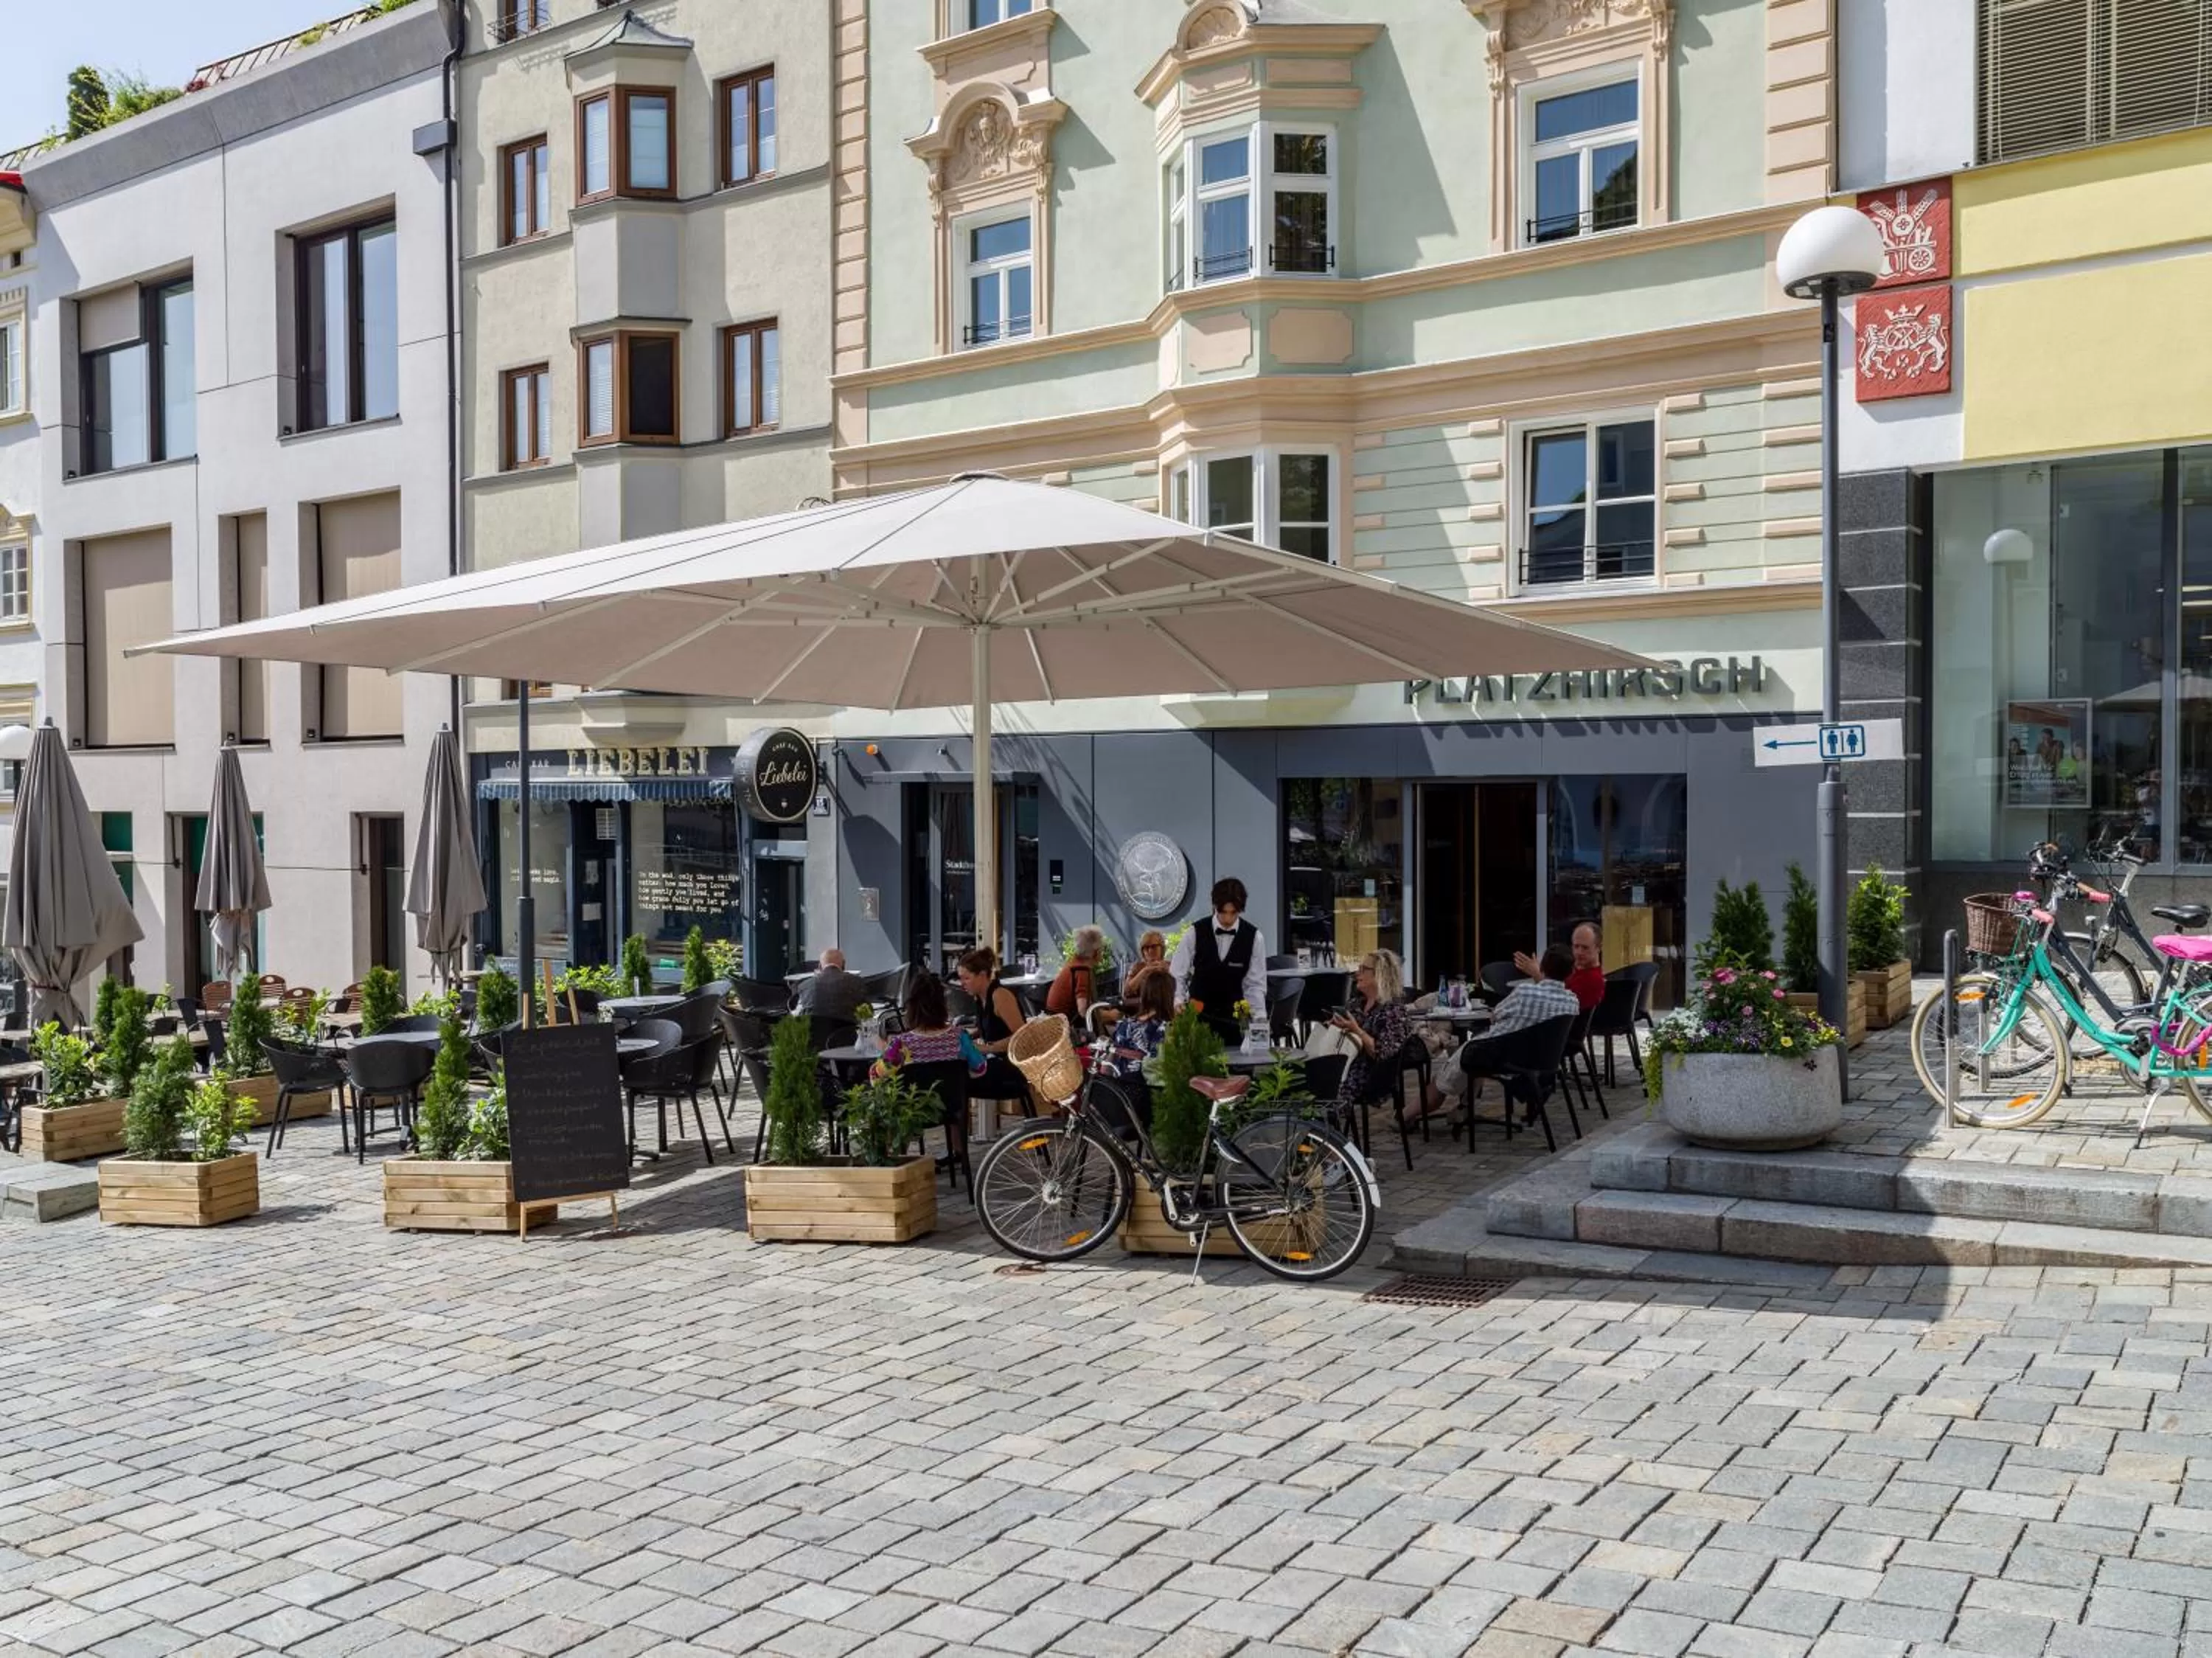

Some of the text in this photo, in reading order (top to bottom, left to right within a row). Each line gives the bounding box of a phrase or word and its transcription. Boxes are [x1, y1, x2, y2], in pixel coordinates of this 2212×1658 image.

[566, 746, 710, 776] LIEBELEI
[759, 760, 809, 787] Liebelei
[678, 873, 693, 881] only
[652, 888, 672, 896] gently
[693, 898, 704, 906] you
[731, 899, 740, 907] of
[639, 903, 660, 912] things
